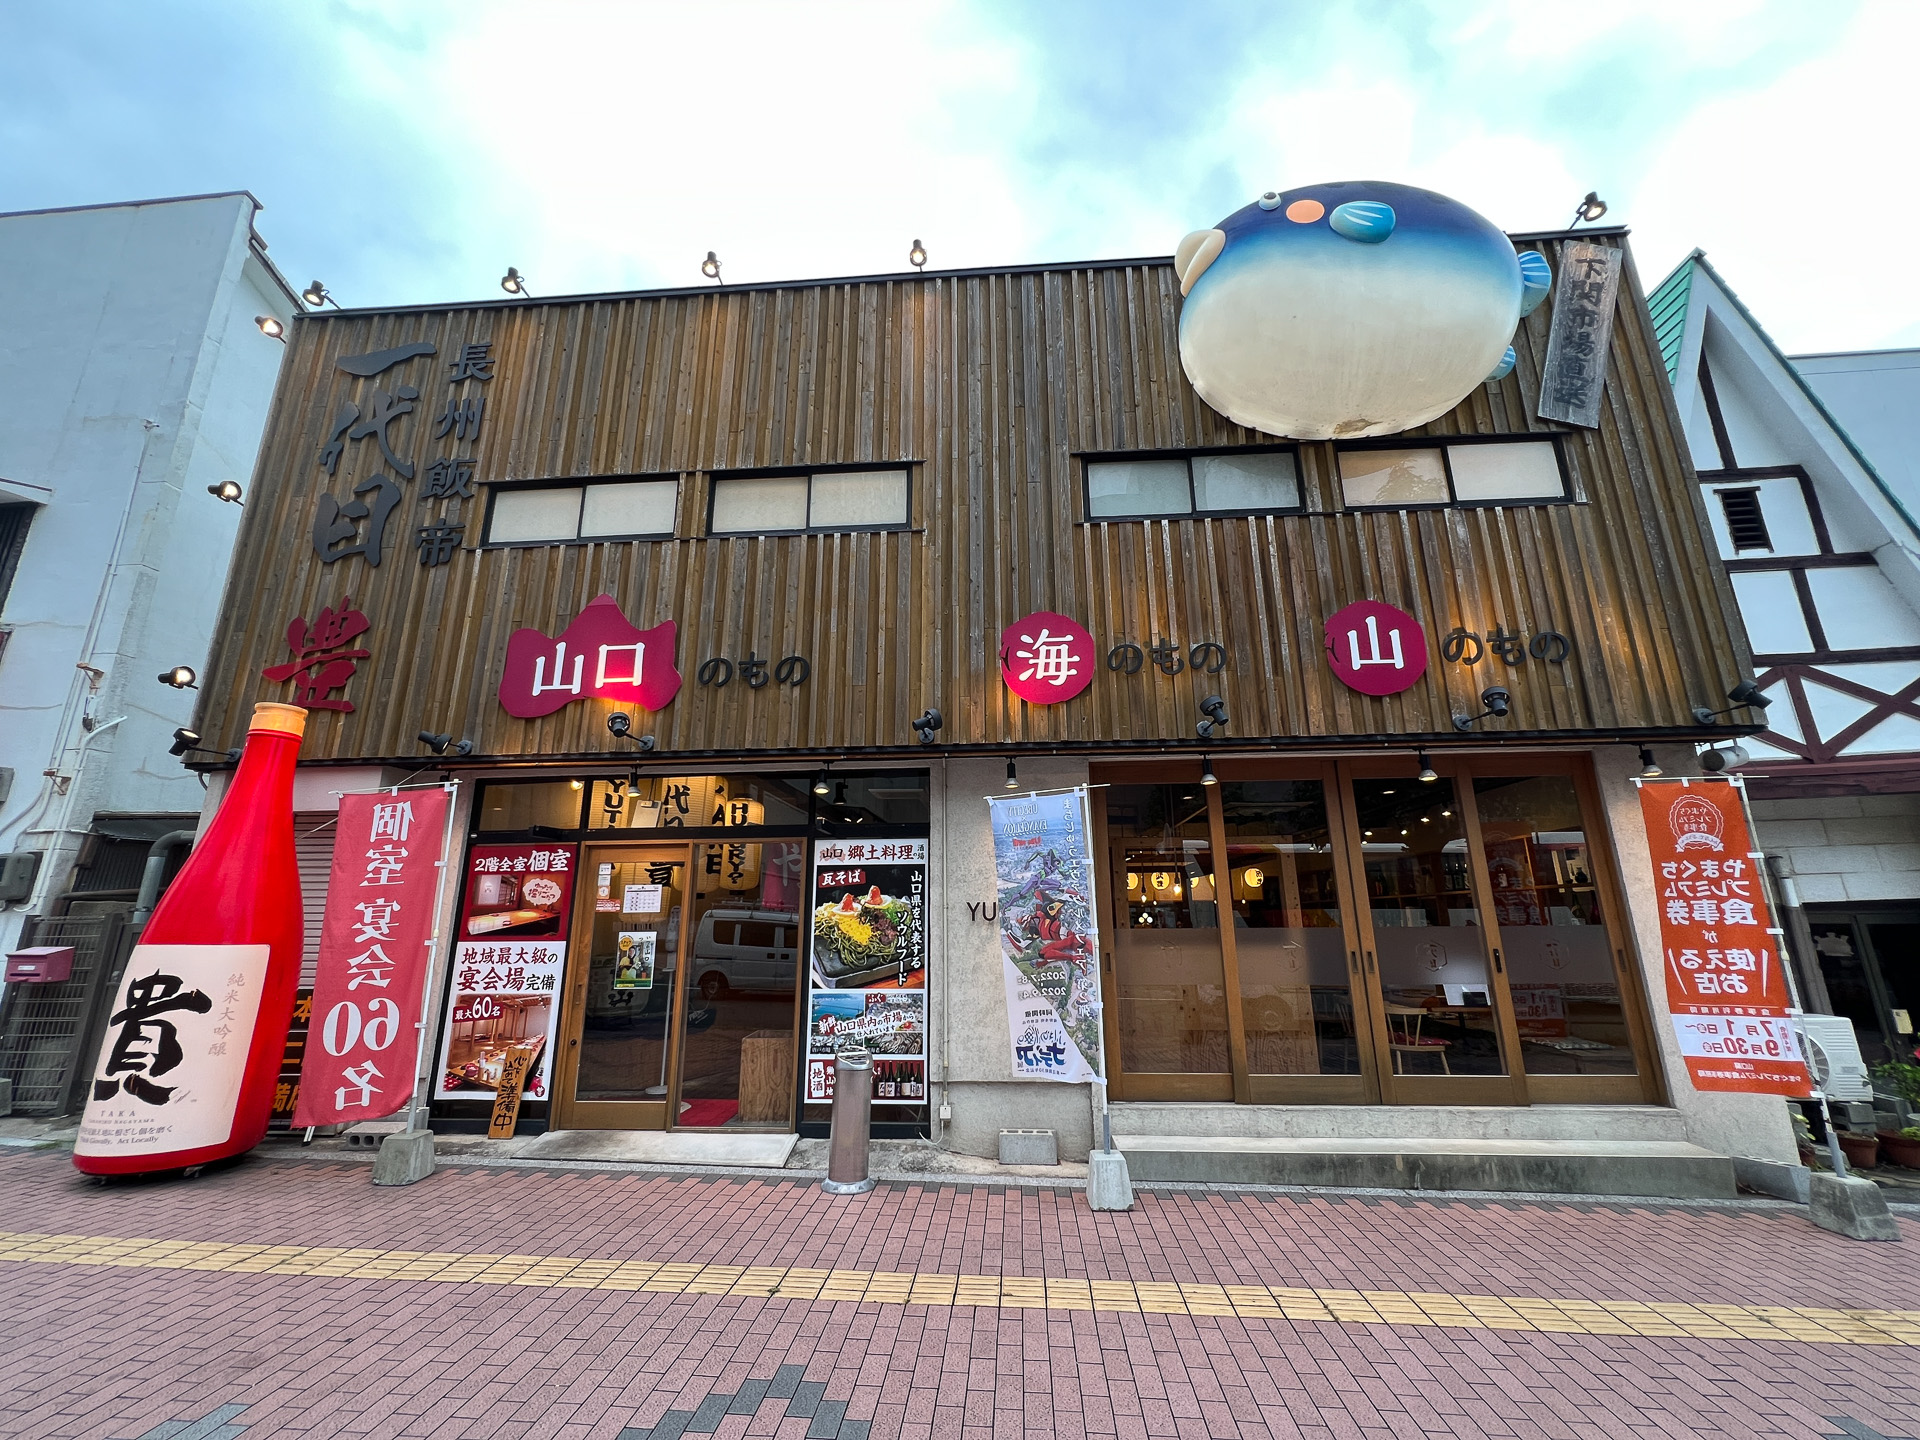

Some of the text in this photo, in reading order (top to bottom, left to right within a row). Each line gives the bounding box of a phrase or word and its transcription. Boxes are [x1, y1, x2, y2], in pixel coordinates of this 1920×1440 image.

[312, 342, 437, 567] 一代目
[414, 342, 495, 567] 長州飯帝
[531, 641, 811, 697] 山口 のもの
[1017, 628, 1227, 687] 海 のもの
[1347, 615, 1572, 671] 山 のもの
[474, 848, 571, 872] 2階全室個室
[821, 869, 861, 886] 瓦そば
[910, 870, 923, 969] 山口県を代表する
[461, 946, 558, 965] 地域最大級の
[896, 910, 908, 987] ソウルフード
[456, 965, 556, 992] 宴会場完備
[868, 993, 884, 1003] ふぐ
[454, 996, 501, 1020] 最大60名
[93, 968, 213, 1107] 貴
